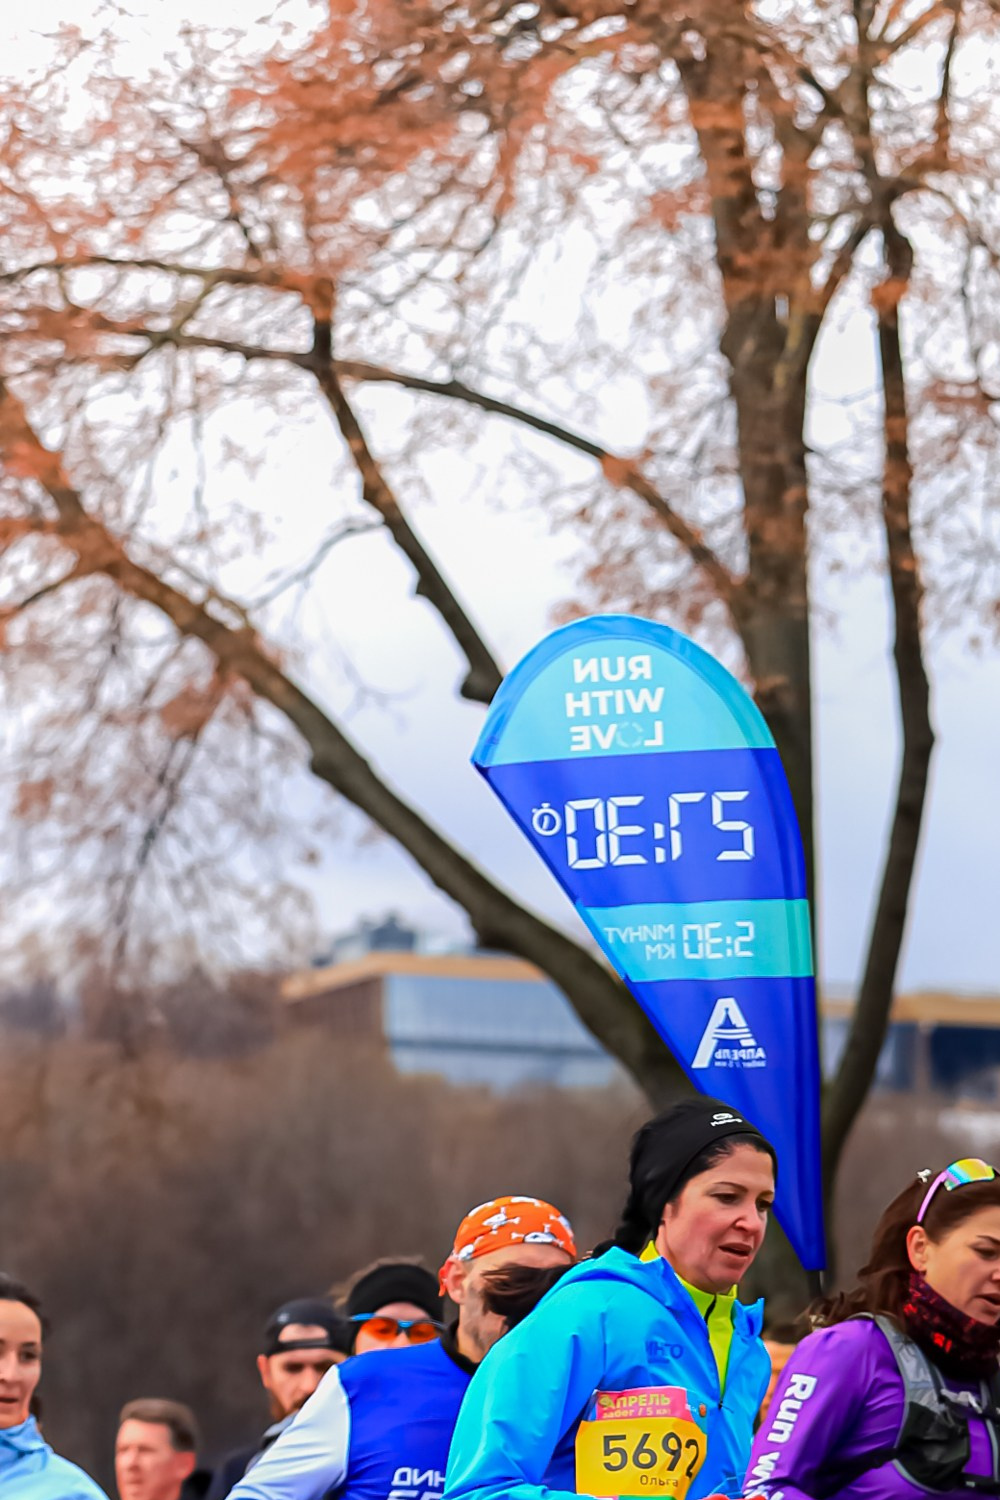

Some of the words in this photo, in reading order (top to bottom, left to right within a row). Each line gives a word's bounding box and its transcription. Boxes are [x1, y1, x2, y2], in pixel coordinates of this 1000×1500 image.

[767, 1373, 818, 1443] Run
[602, 1432, 699, 1479] 5692
[640, 1474, 679, 1488] Ольга
